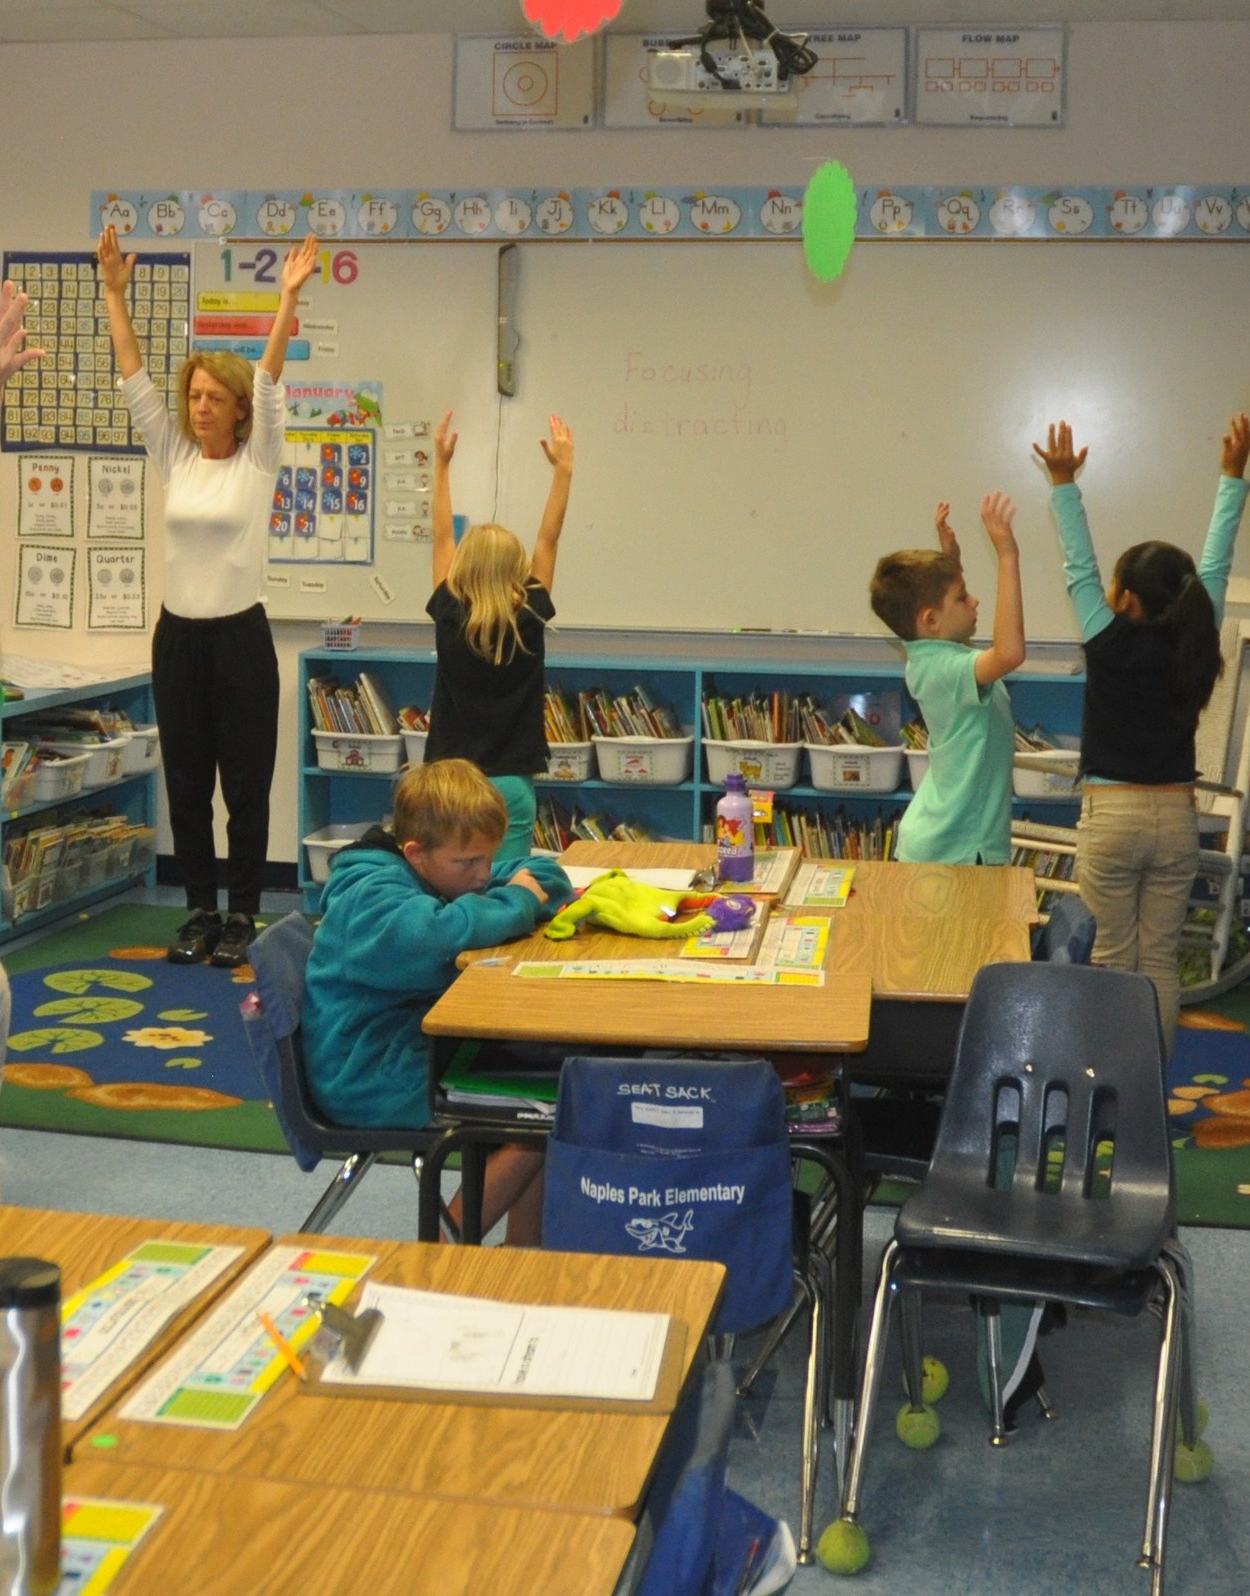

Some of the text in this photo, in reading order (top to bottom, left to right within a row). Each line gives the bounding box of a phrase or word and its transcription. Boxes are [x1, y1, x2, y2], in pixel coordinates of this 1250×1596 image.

[837, 33, 861, 43] MAP
[962, 34, 1020, 44] FLOW MAP
[494, 41, 558, 50] CIRCLE MAP
[110, 204, 130, 218] Aa
[157, 204, 176, 218] Bb
[207, 204, 228, 218] Cc
[267, 203, 286, 217] Dd
[318, 203, 336, 217] Ee
[368, 202, 386, 216] Ff
[420, 202, 441, 221] Gg
[463, 201, 482, 215] Hh
[509, 201, 518, 216] Ii
[547, 201, 562, 221] Jj
[599, 201, 617, 215] Kk
[652, 200, 666, 215] Ll
[702, 201, 729, 215] Mm
[772, 201, 791, 214] Nn
[882, 200, 901, 221] Pp
[947, 200, 973, 221] Qq
[1062, 200, 1080, 214] Ss
[1123, 200, 1137, 214] Tt
[1206, 200, 1223, 214] Vv
[221, 249, 359, 285] 1-2-16
[14, 267, 183, 279] 1 2 3 4 5 8 9 10
[31, 285, 39, 293] 12
[65, 285, 74, 294] 14
[138, 286, 147, 296] 18
[157, 287, 166, 296] 19
[44, 303, 55, 313] 23
[62, 303, 75, 313] 24
[137, 304, 148, 313] 28
[155, 305, 167, 314] 29
[43, 321, 55, 330] 33
[63, 321, 75, 330] 34
[153, 323, 165, 332] 39
[43, 338, 55, 347] 43
[61, 338, 73, 347] 44
[97, 339, 108, 349] 46
[153, 341, 165, 350] 49
[42, 358, 53, 368] 53
[59, 358, 71, 367] 54
[97, 358, 108, 368] 56
[151, 359, 162, 369] 59
[25, 375, 36, 384] 62
[44, 375, 55, 384] 63
[97, 376, 109, 386] 66
[7, 392, 18, 401] 71
[25, 392, 36, 401] 72
[42, 392, 53, 401] 73
[61, 392, 73, 401] 74
[100, 393, 111, 402] 76
[8, 411, 18, 420] 81
[24, 411, 36, 420] 82
[43, 412, 55, 421] 83
[60, 412, 72, 421] 84
[95, 413, 107, 422] 86
[114, 414, 125, 422] 87
[614, 400, 787, 452] distracting
[9, 429, 19, 438] 91
[26, 429, 37, 438] 92
[41, 430, 52, 440] 93
[61, 430, 73, 439] 94
[98, 431, 109, 441] 96
[114, 432, 125, 441] 97
[333, 452, 367, 463] 1 2
[32, 463, 60, 474] Penny
[102, 465, 130, 474] Nickel
[282, 474, 366, 487] 6 7 8 9
[281, 498, 364, 511] 13 14 15 16
[276, 520, 313, 532] 20 21
[36, 553, 58, 563] Dime
[96, 555, 135, 564] Quarter
[302, 581, 324, 590] Tuesday
[617, 1083, 712, 1100] SEAT SACK
[580, 1176, 746, 1207] Naples Park Elementary
